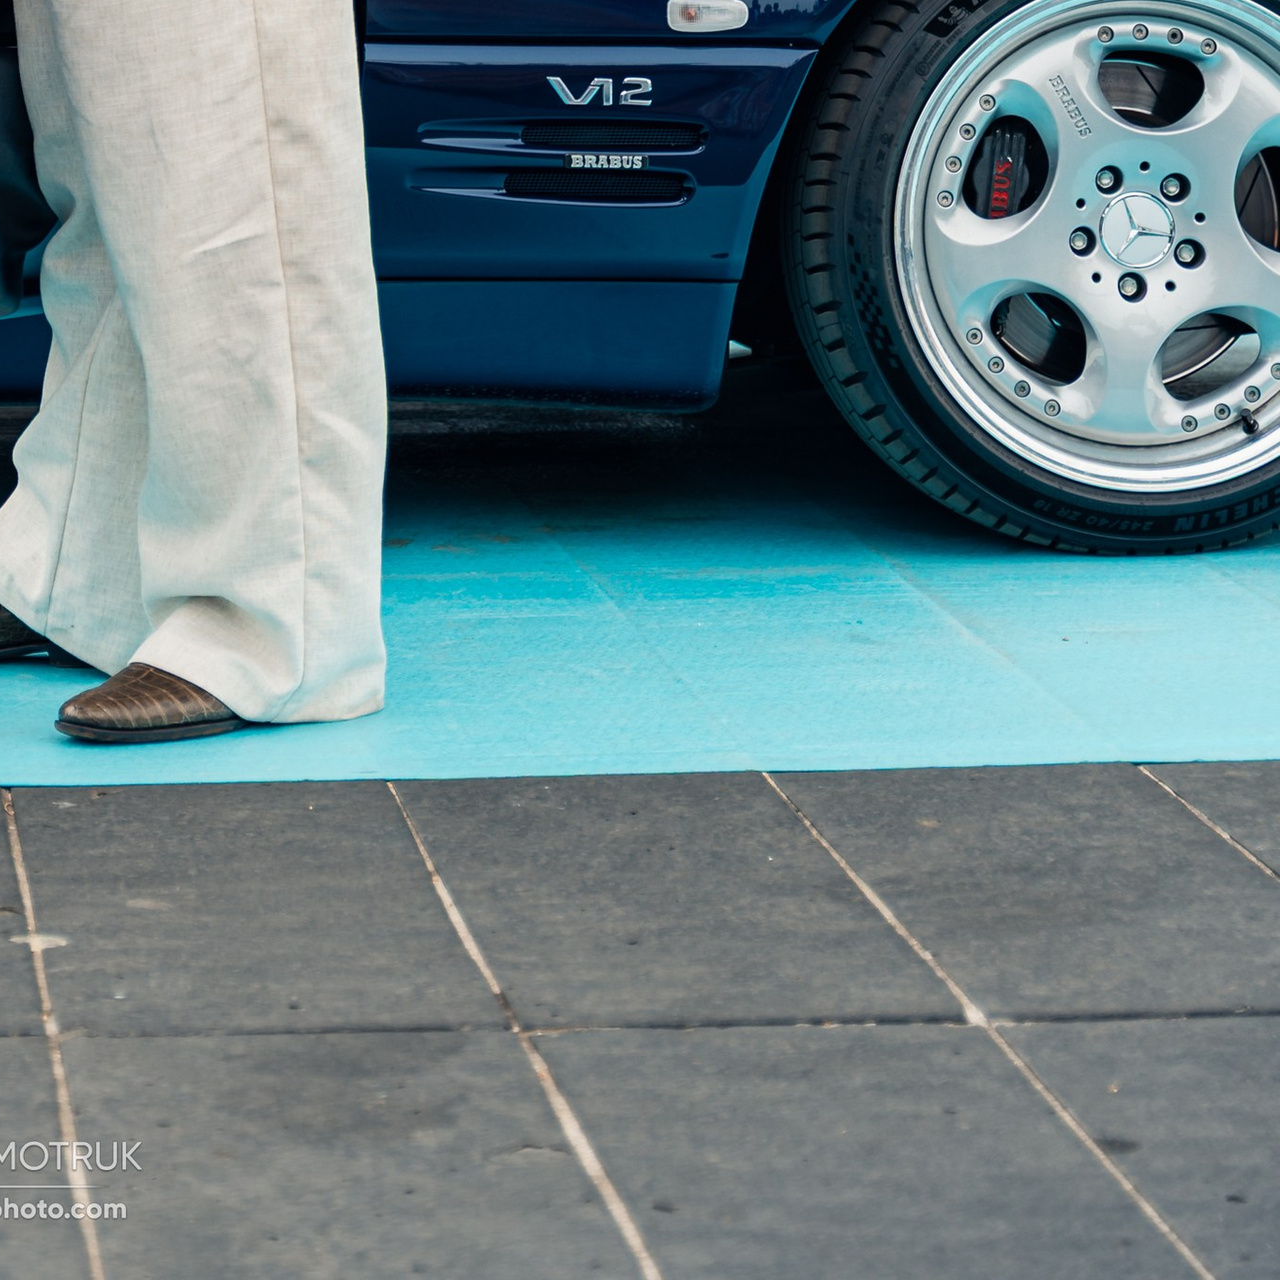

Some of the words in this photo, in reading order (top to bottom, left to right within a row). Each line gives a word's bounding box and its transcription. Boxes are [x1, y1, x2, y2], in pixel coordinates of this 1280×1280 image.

[545, 75, 653, 107] V12
[1048, 74, 1093, 138] BRABUS
[570, 154, 643, 170] BRABUS
[989, 159, 1013, 219] BUS
[1173, 487, 1280, 532] HELIN
